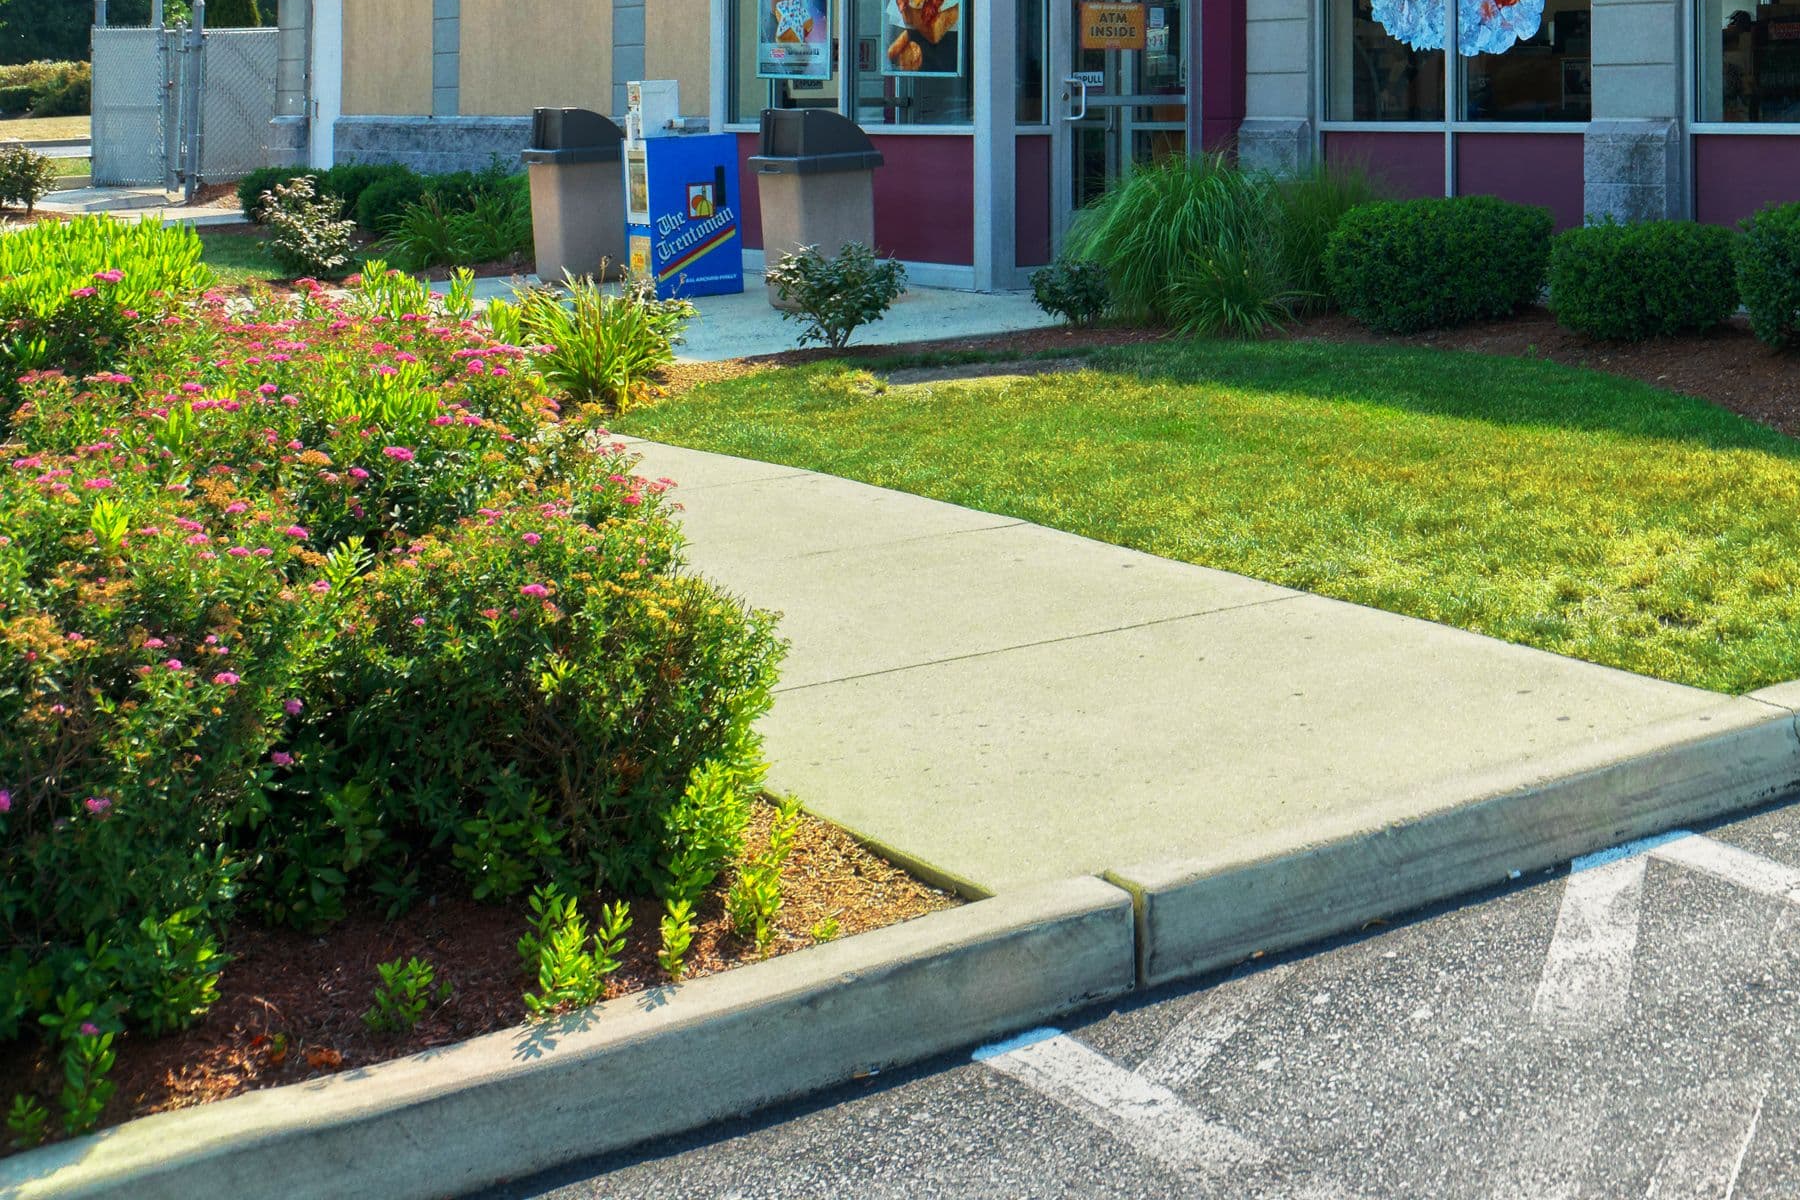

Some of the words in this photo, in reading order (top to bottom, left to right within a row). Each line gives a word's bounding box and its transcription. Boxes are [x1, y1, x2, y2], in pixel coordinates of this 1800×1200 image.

[1099, 12, 1127, 23] ATM
[1091, 26, 1136, 37] INSIDE
[1083, 74, 1102, 84] PULL
[656, 209, 686, 239] The
[656, 206, 735, 265] Trentonian
